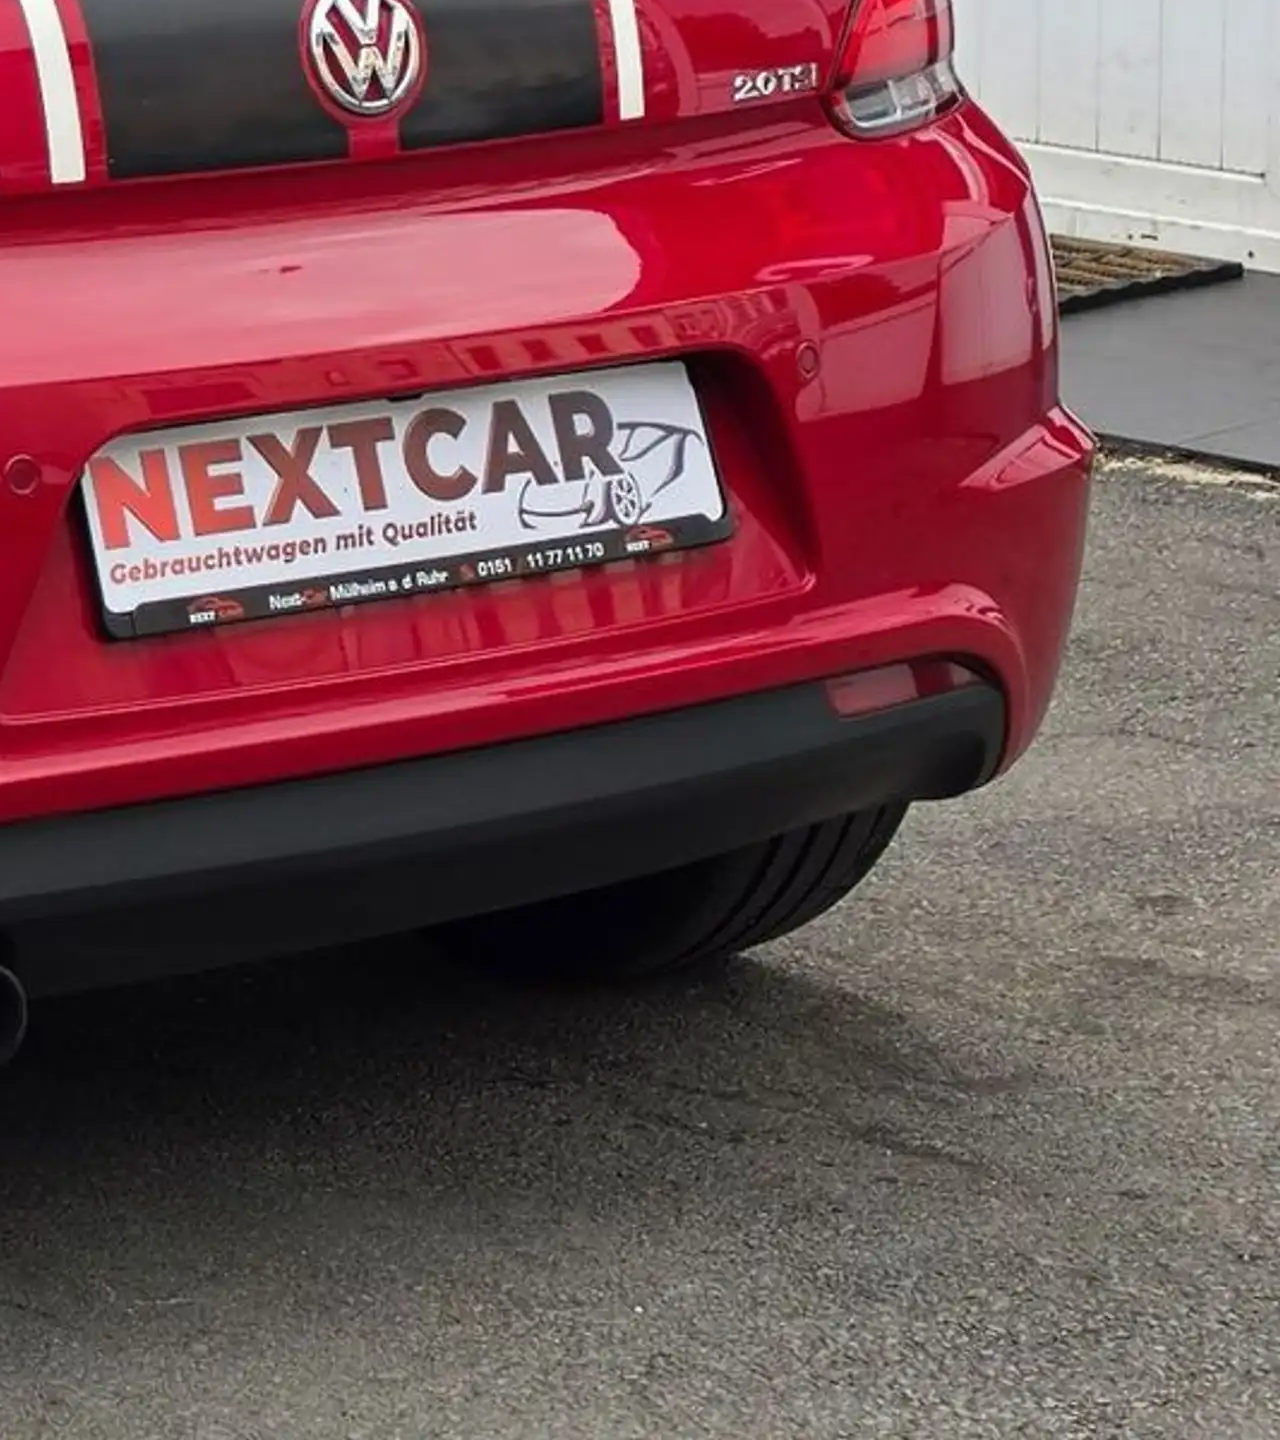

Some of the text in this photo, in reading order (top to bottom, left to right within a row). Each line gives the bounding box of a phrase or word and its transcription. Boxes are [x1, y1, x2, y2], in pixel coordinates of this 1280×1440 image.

[85, 390, 626, 551] NEXTCAR
[110, 511, 478, 585] Gebrauchtwagen mit Qualität
[477, 557, 512, 576] 0151
